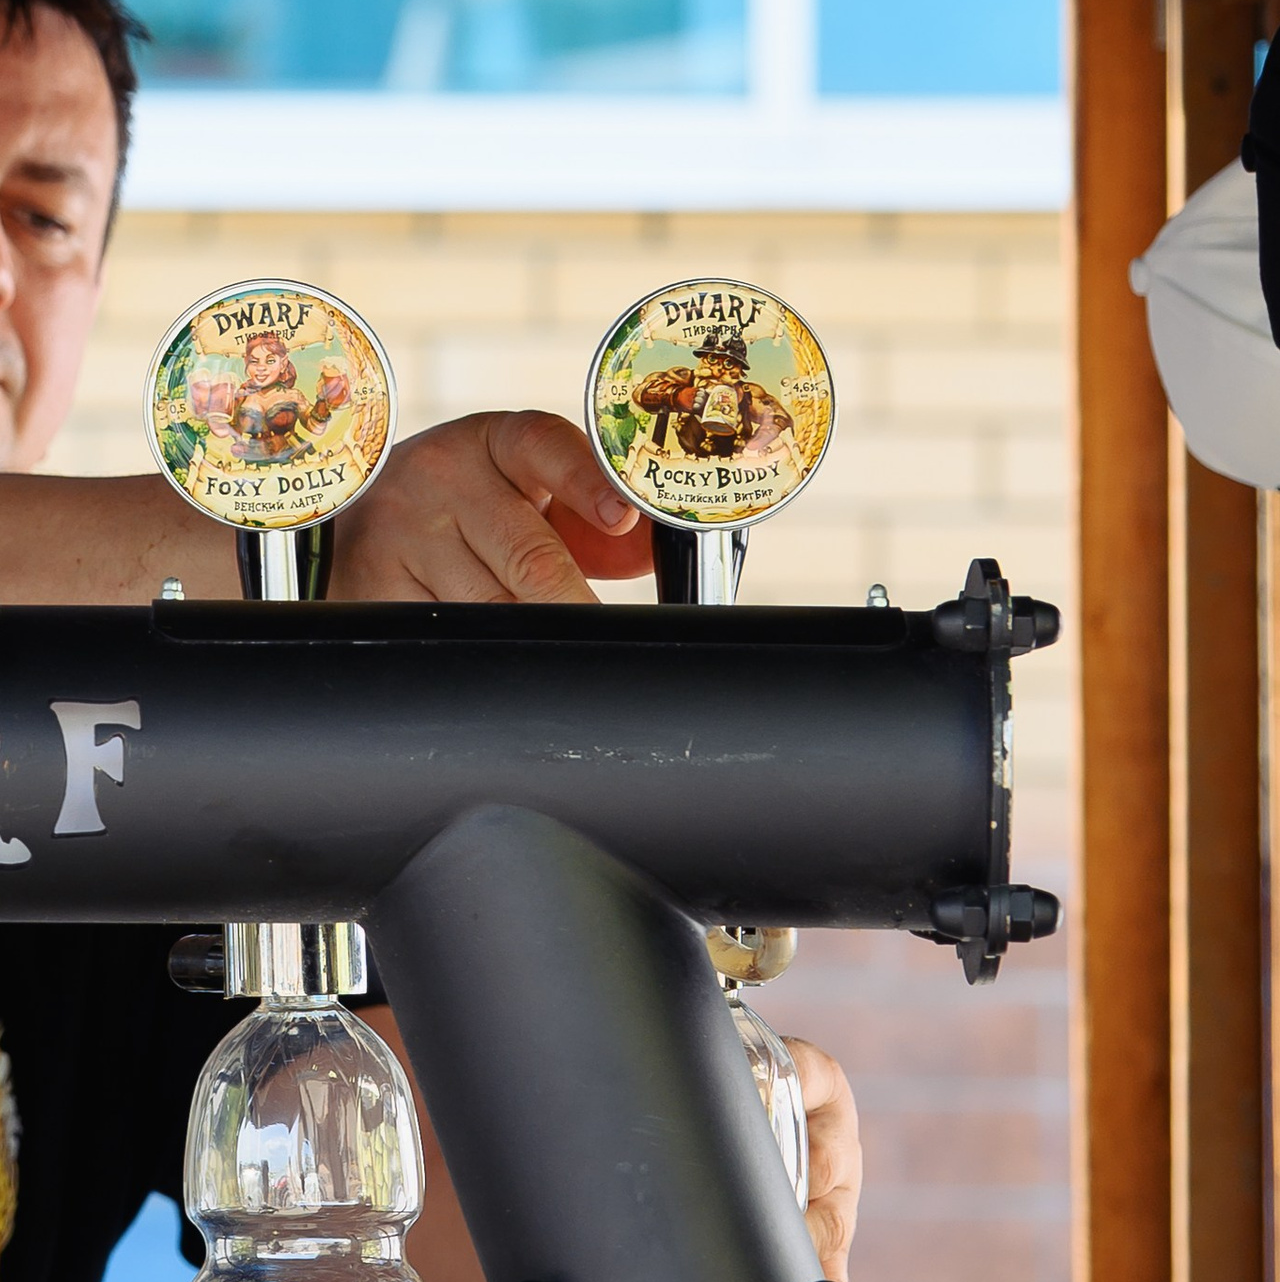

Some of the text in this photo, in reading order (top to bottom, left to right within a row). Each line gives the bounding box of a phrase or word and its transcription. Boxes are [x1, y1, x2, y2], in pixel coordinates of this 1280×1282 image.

[212, 302, 313, 336] DWARF
[660, 292, 766, 327] DWARF
[611, 385, 628, 397] 0,5
[170, 403, 187, 415] 0,5
[205, 462, 347, 497] FOXY DOLLY
[234, 493, 324, 512] ВЕНСКИЙ ЛАГЕР
